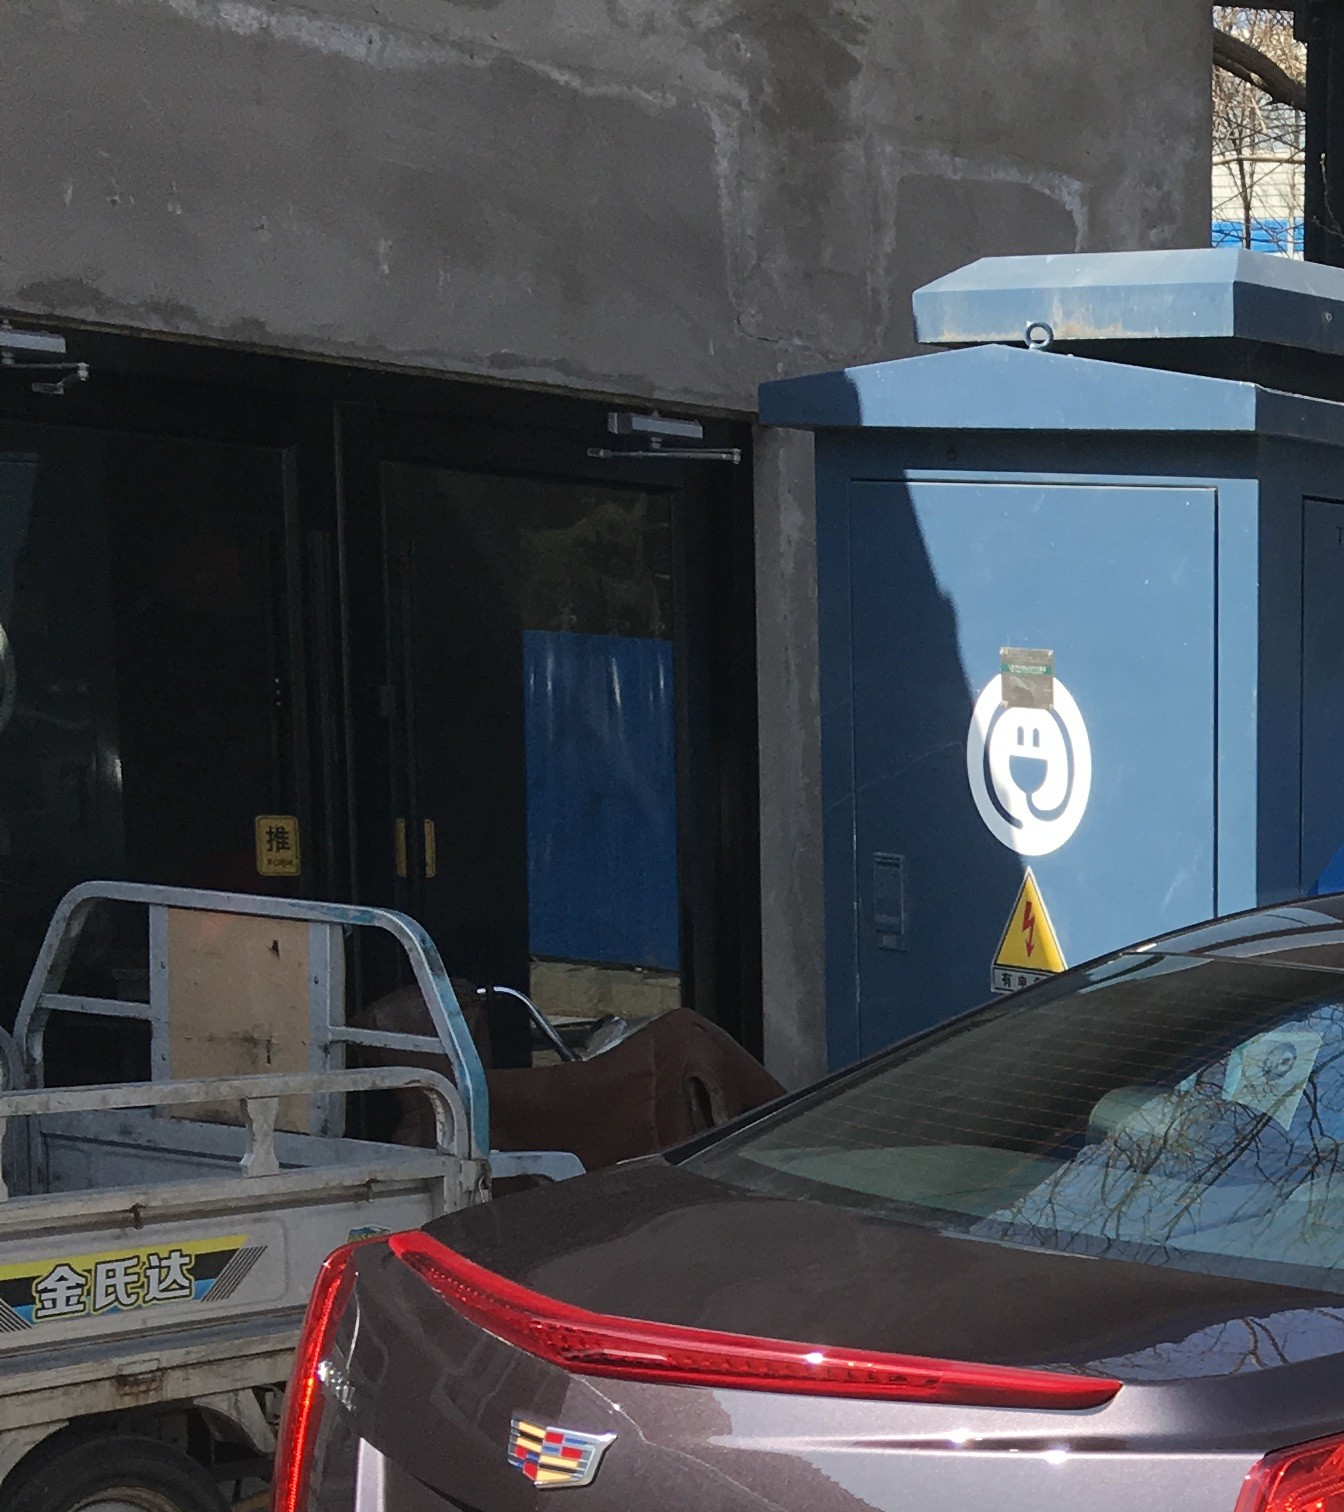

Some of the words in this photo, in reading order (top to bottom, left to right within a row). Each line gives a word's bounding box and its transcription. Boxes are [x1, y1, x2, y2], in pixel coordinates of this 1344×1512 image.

[265, 825, 291, 853] 推
[35, 1249, 195, 1320] 金氏达
